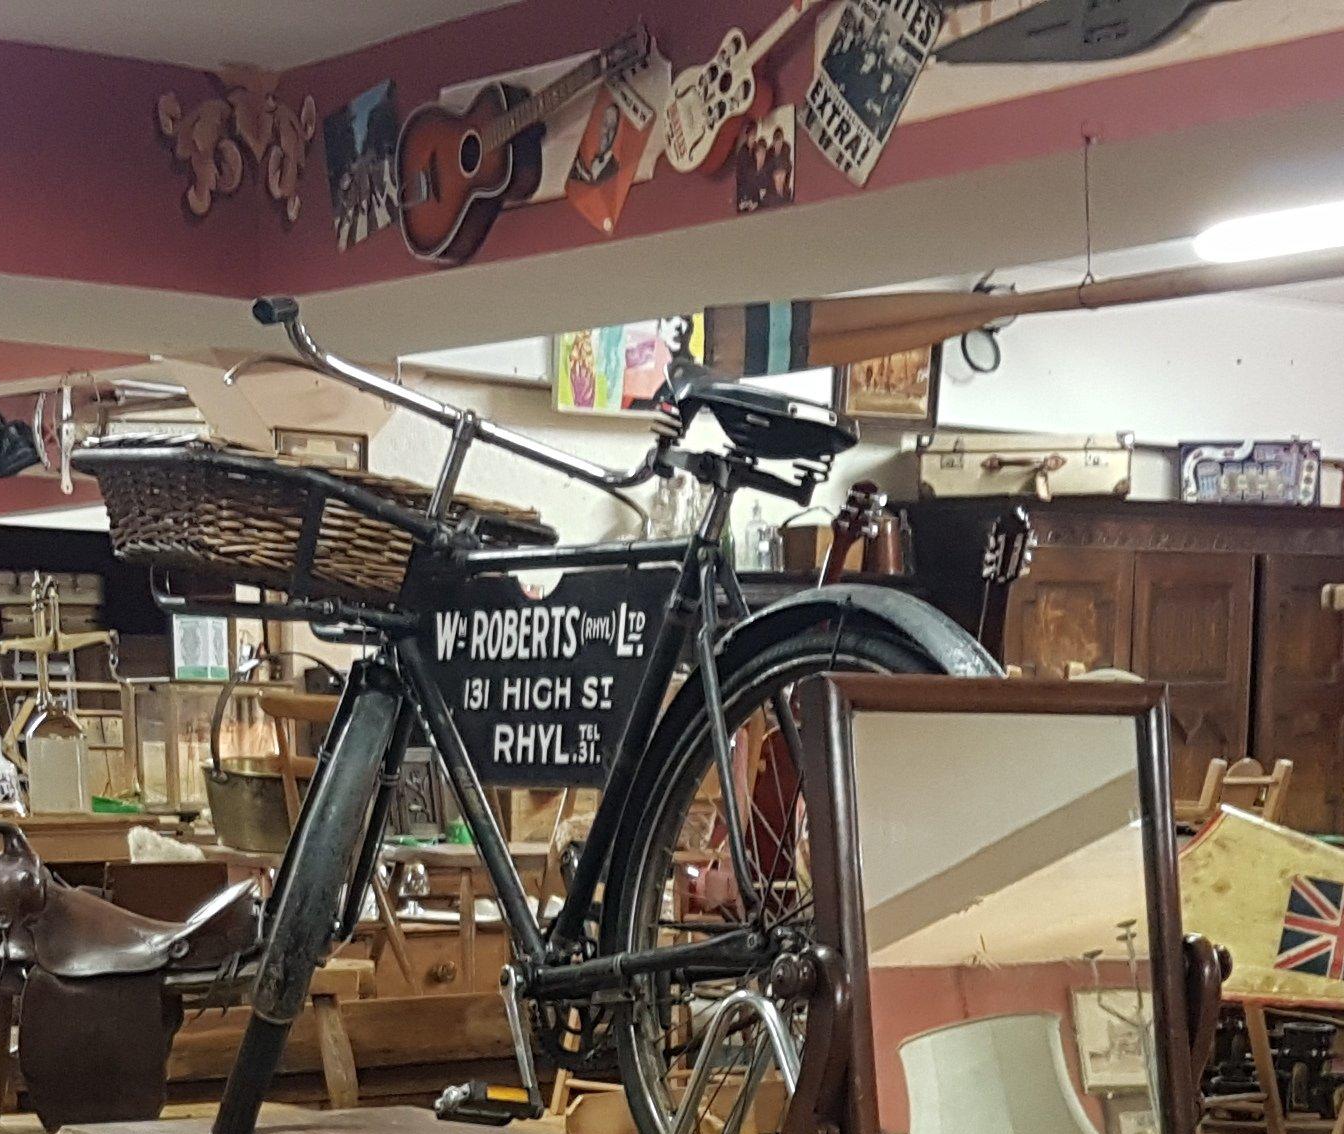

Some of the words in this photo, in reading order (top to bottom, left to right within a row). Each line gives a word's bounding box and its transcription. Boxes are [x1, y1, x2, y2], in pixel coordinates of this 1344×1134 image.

[471, 606, 580, 660] ROBERTS
[580, 611, 616, 646] (RHYL)
[464, 678, 490, 711] 131
[502, 677, 572, 711] HIGH
[578, 724, 601, 741] TEL
